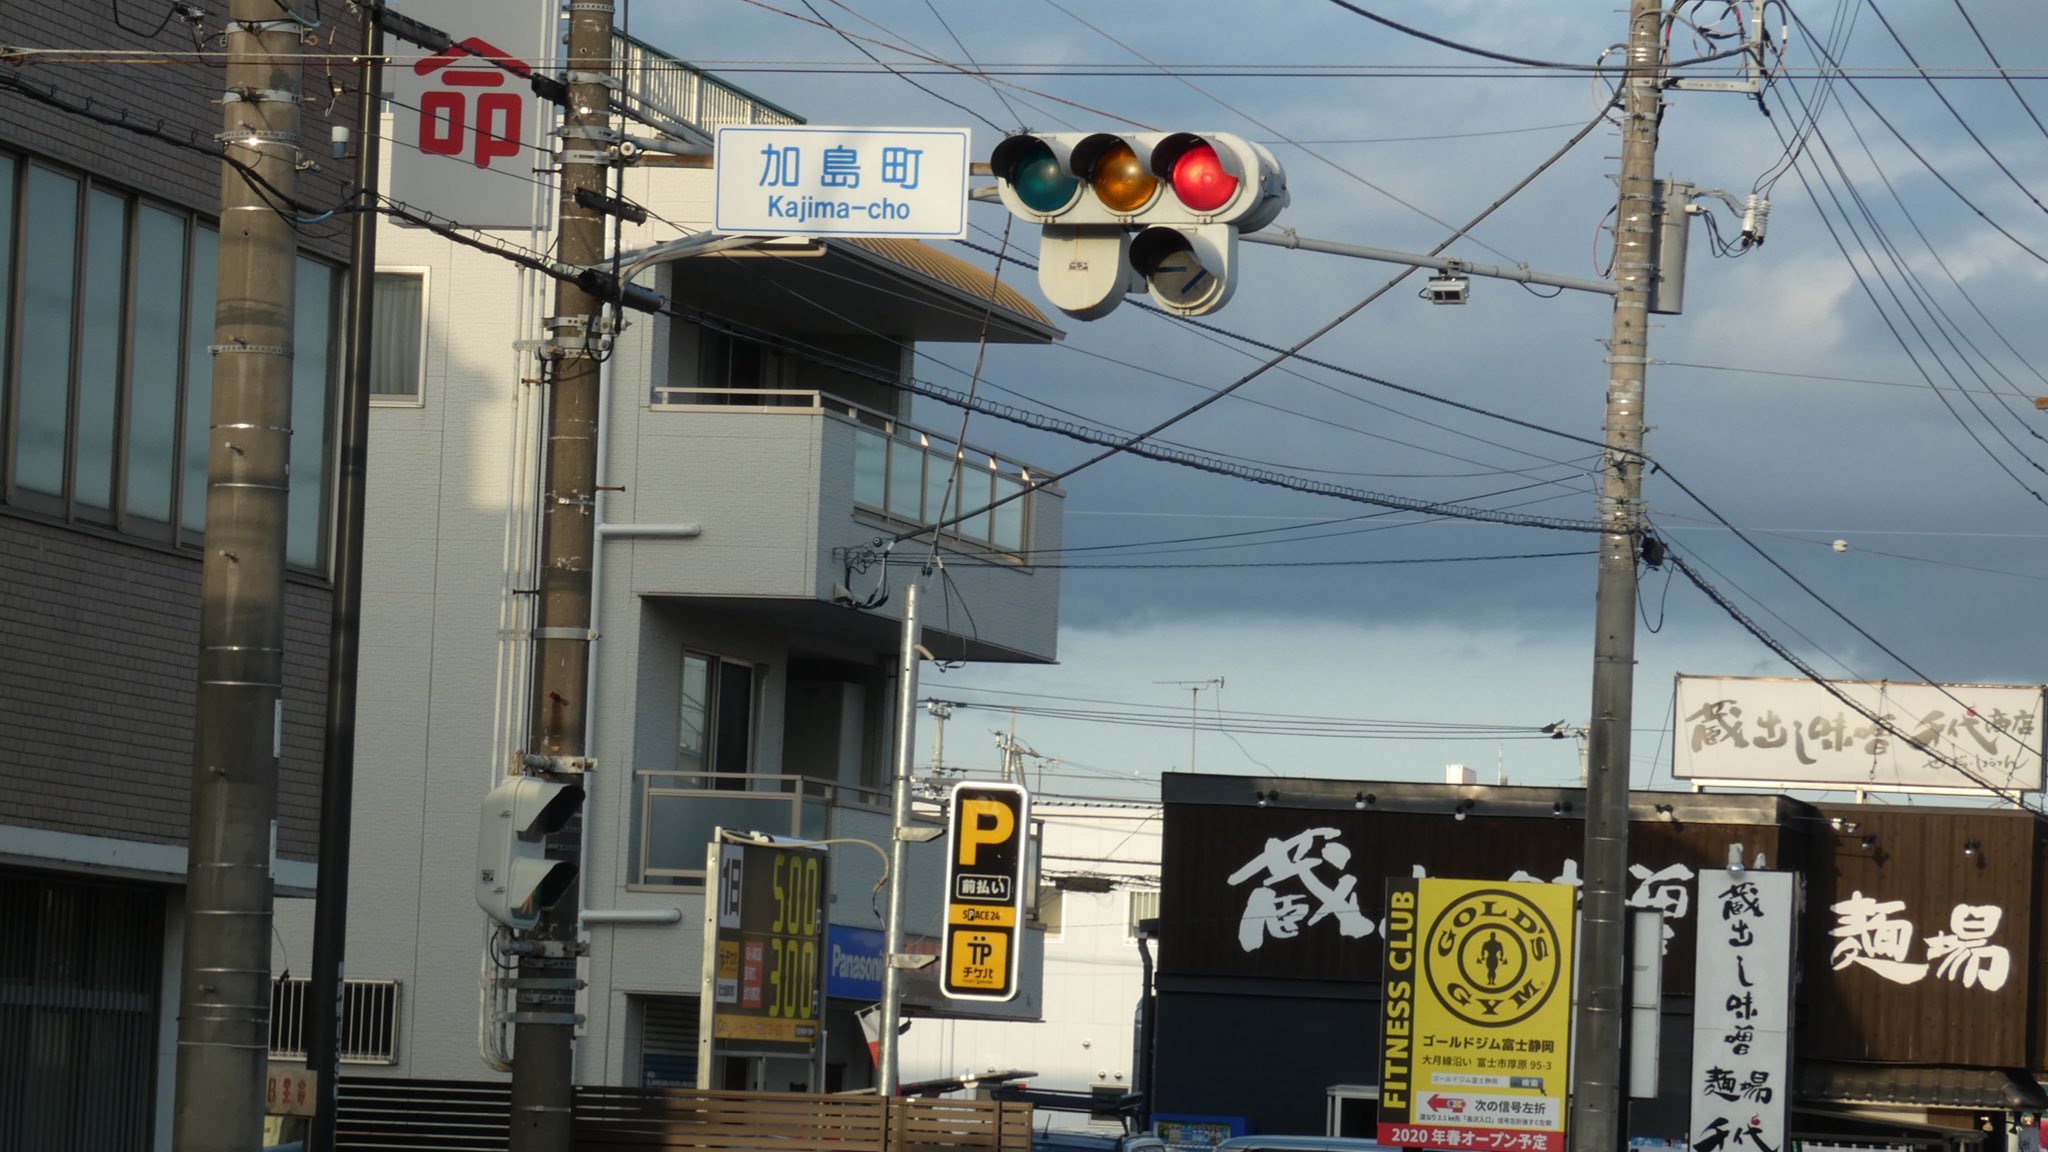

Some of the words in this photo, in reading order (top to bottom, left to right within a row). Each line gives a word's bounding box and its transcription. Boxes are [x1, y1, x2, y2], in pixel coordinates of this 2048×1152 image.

[759, 143, 923, 190] 加島町
[768, 195, 910, 223] Kajima-cho
[959, 799, 1015, 866] P
[772, 854, 818, 936] 500
[961, 879, 1004, 895] 前払い
[1389, 891, 1415, 971] CLUB
[1438, 901, 1549, 962] GOLD'S
[769, 938, 815, 1019] 300
[831, 944, 884, 981] Panasoni
[1447, 978, 1541, 1016] GYM
[1384, 981, 1412, 1109] FITNESS
[1423, 1034, 1555, 1054] ゴールドジム富士静岡
[1477, 1057, 1527, 1069] 富士市厚原
[1475, 1099, 1546, 1115] 次の信号左折
[1392, 1127, 1427, 1144] 2020
[1431, 1130, 1548, 1151] 年春オープン予定
